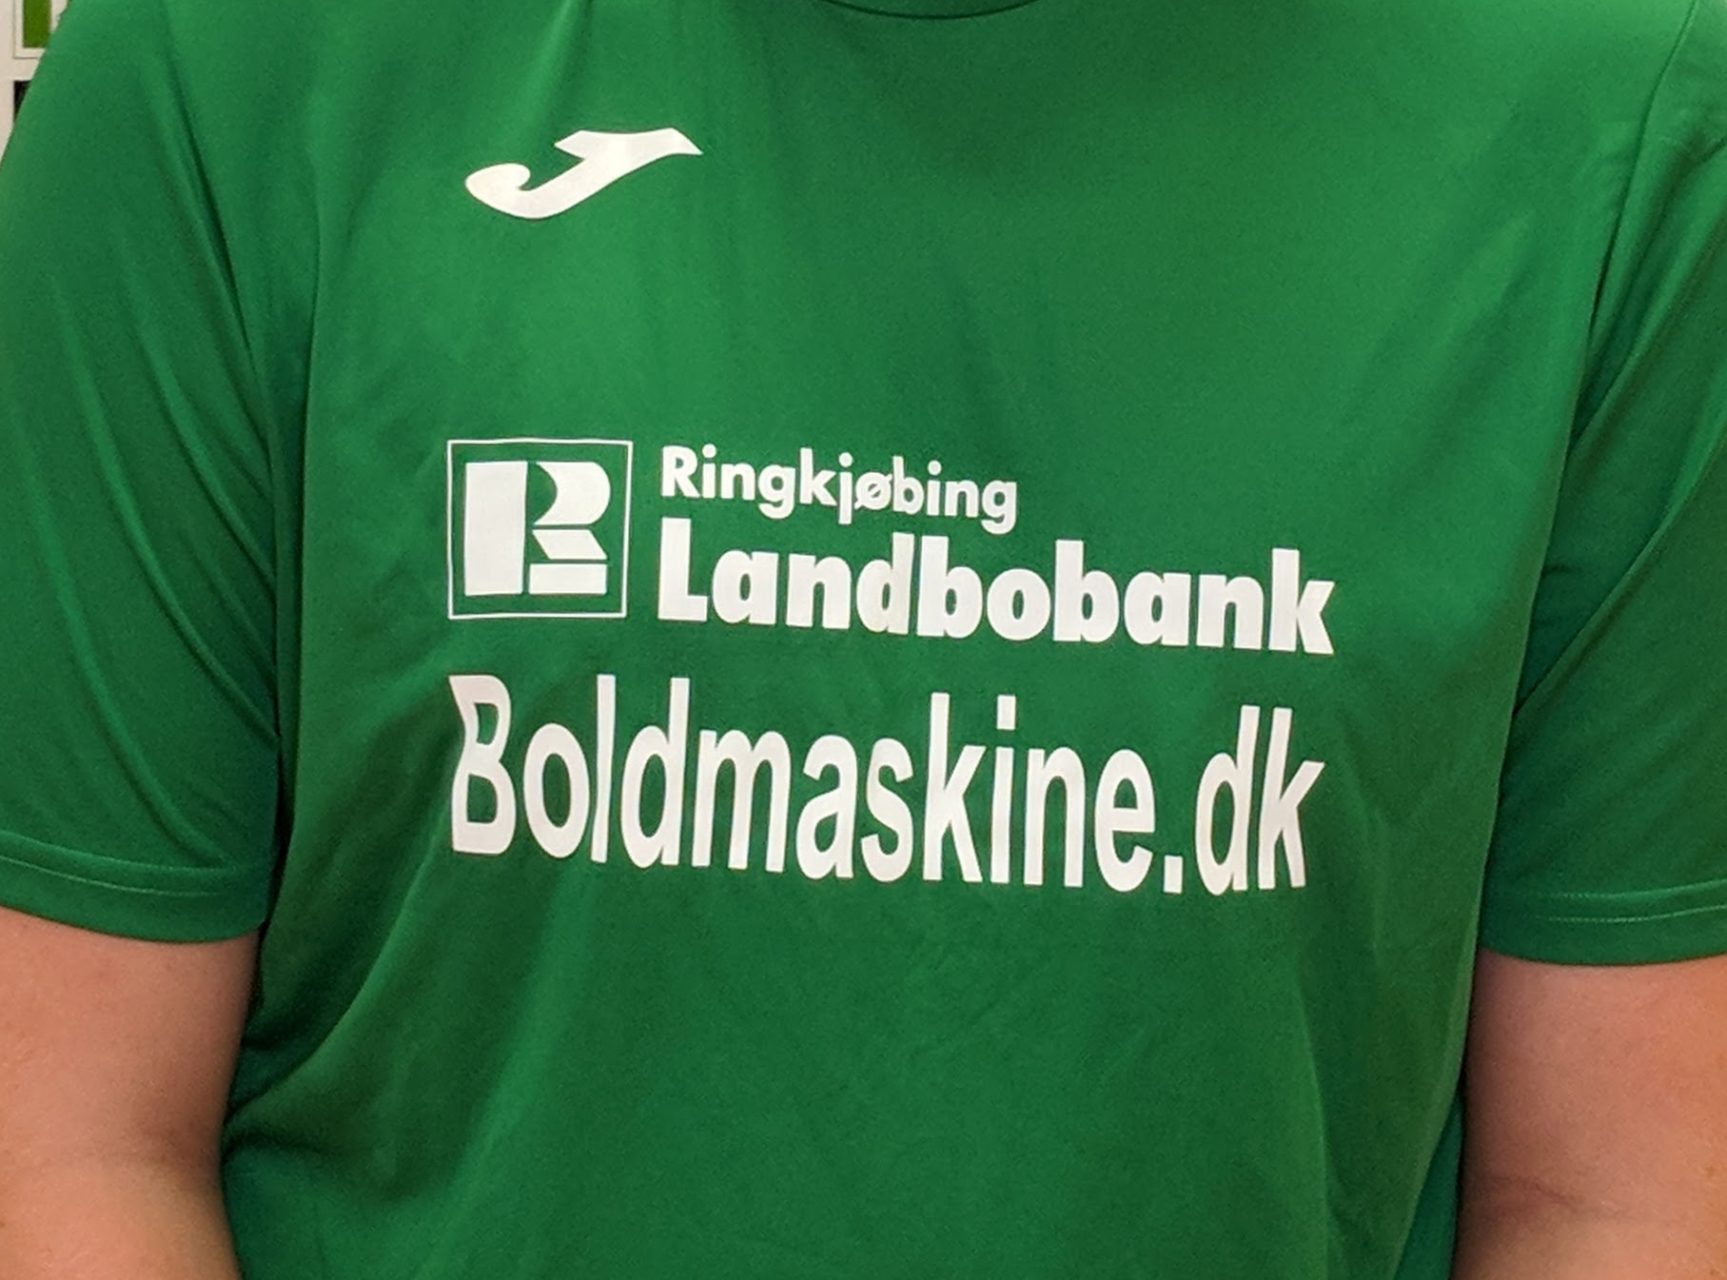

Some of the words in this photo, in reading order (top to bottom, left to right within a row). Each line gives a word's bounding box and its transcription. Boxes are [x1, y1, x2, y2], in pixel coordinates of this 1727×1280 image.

[661, 444, 1018, 534] Ringkjøbing
[657, 518, 1336, 655] Landbobank
[448, 673, 1326, 895] Boldmaskine.dk
